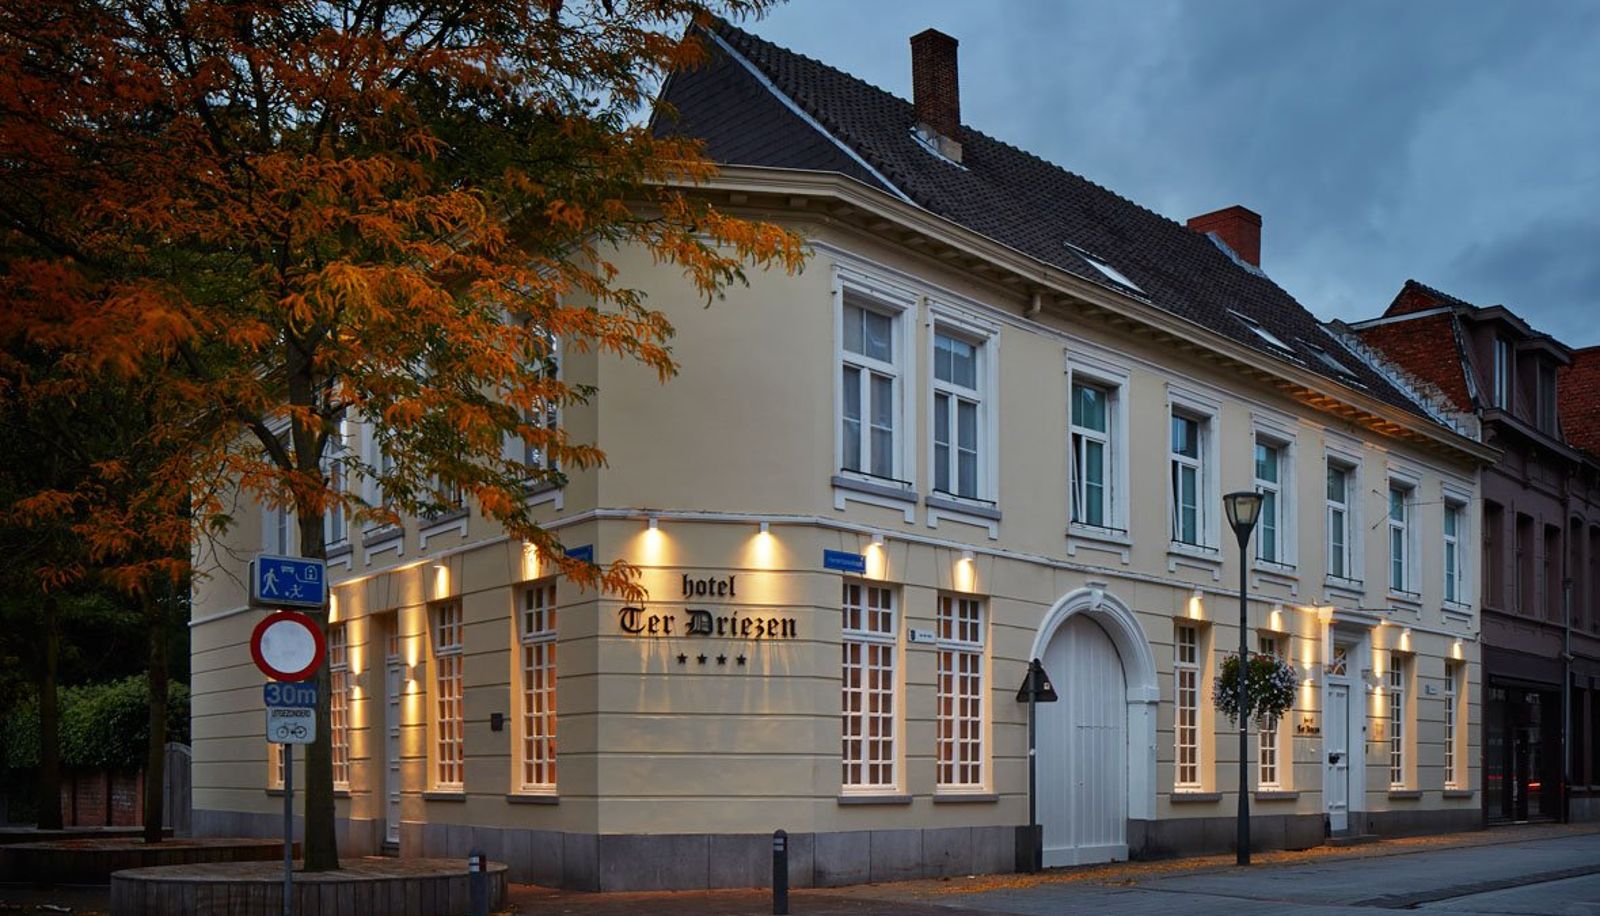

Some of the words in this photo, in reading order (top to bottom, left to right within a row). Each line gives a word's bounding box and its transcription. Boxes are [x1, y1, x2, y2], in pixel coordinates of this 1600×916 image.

[682, 574, 736, 598] hotel
[618, 606, 675, 634] Ter
[685, 607, 797, 641] Driezen
[267, 684, 316, 704] 30m
